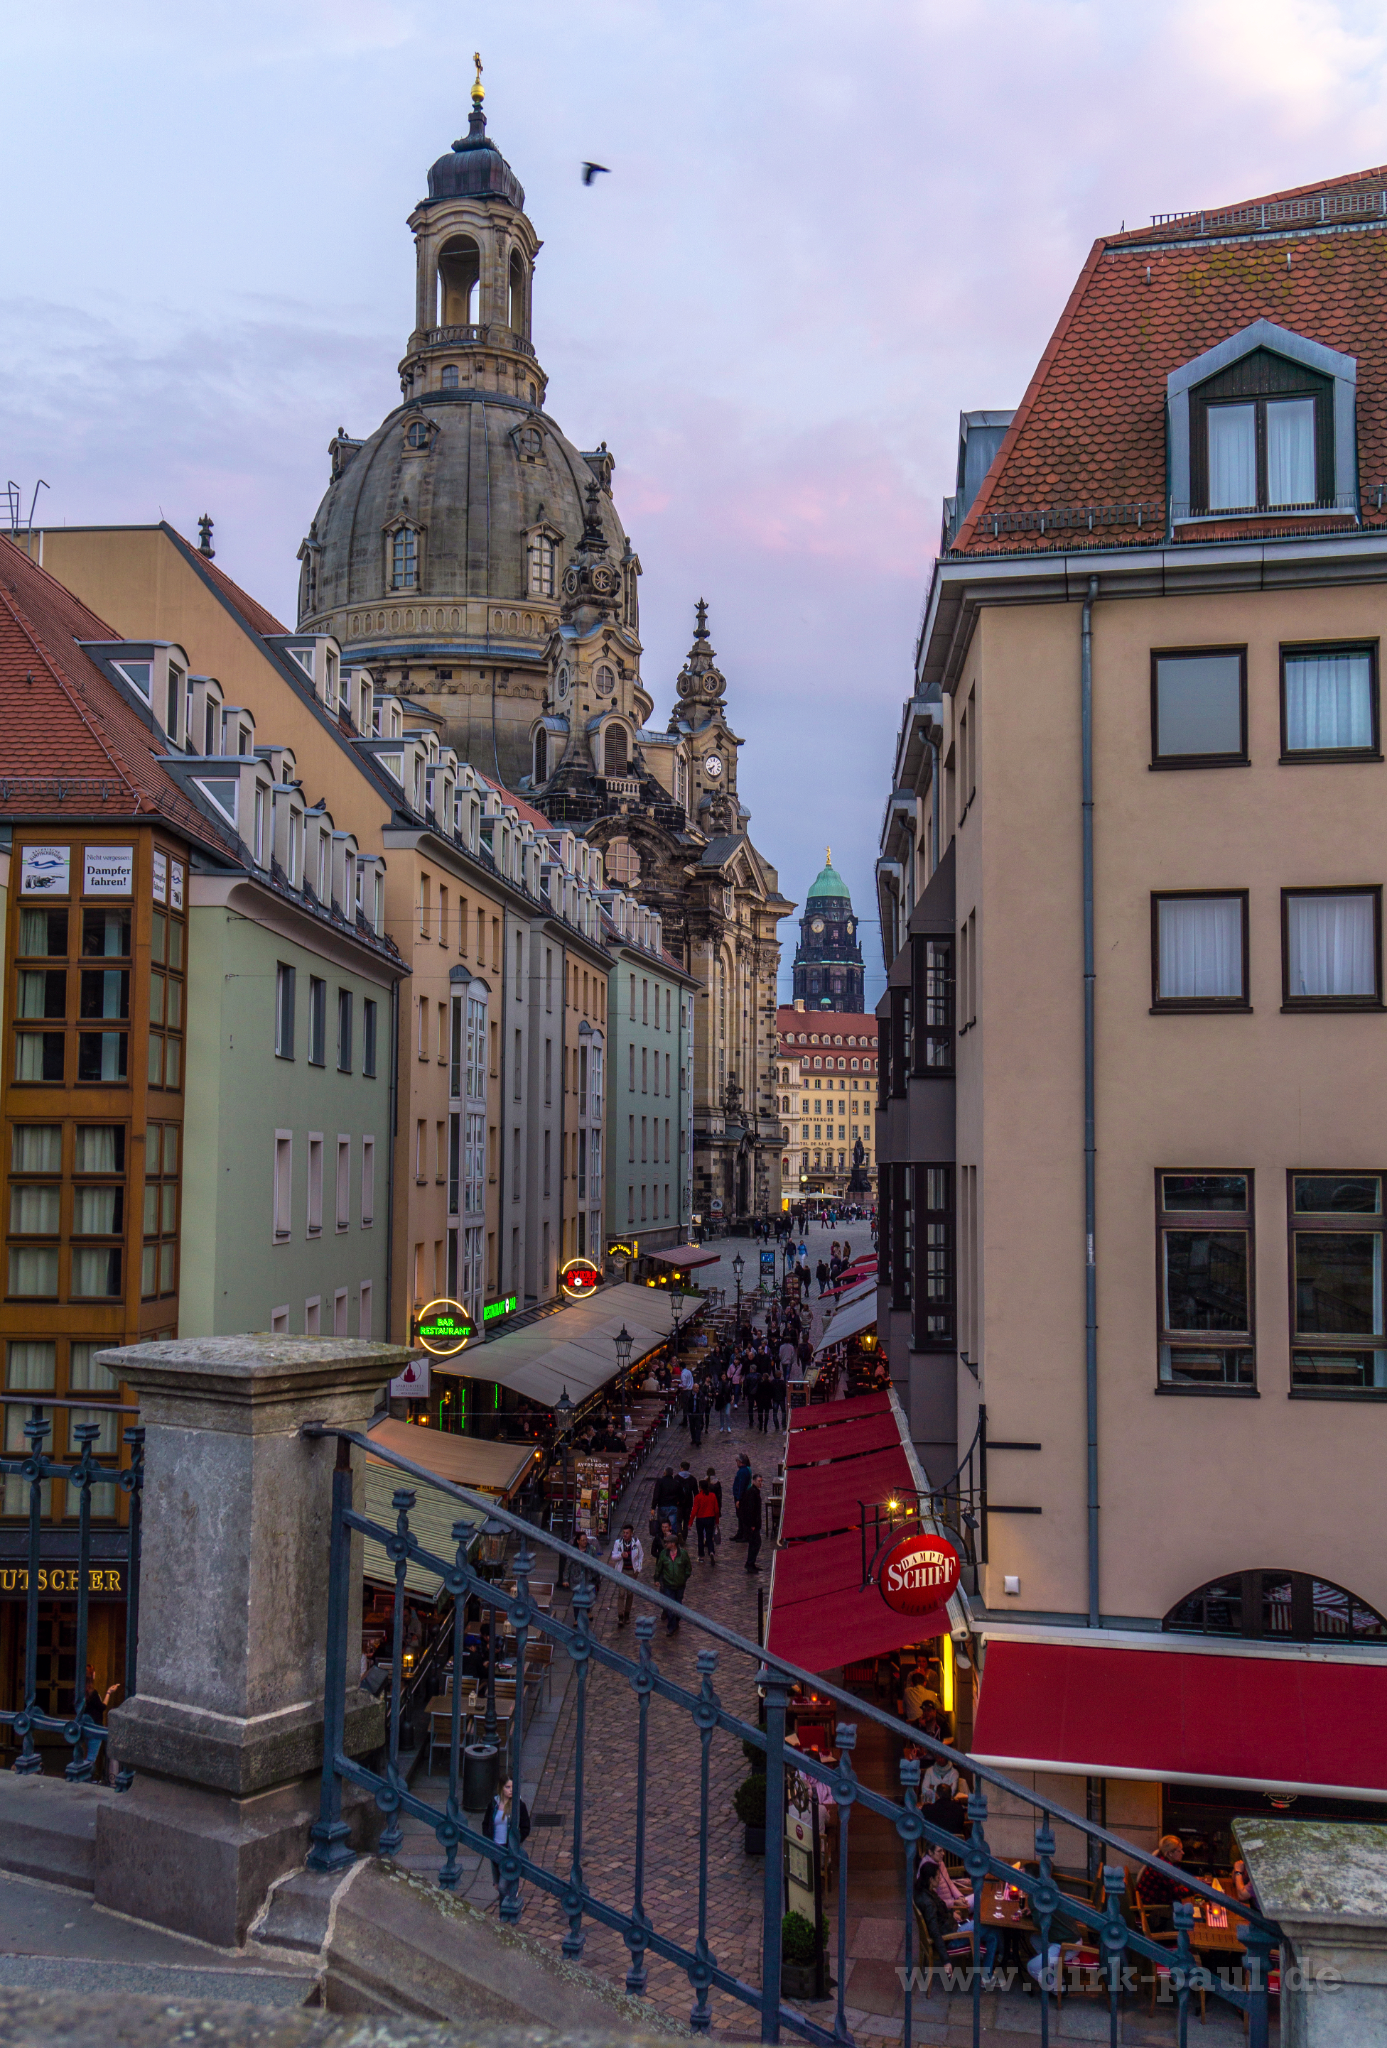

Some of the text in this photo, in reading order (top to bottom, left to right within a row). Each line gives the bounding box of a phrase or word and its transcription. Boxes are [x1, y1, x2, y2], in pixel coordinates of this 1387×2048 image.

[87, 866, 132, 878] Dampfer
[91, 877, 127, 886] fahren!
[566, 1270, 597, 1279] AYERS
[437, 1318, 454, 1327] BAR
[420, 1326, 471, 1336] RESTAURANT
[902, 1551, 944, 1569] DAMPF
[887, 1557, 956, 1591] SCHIFF
